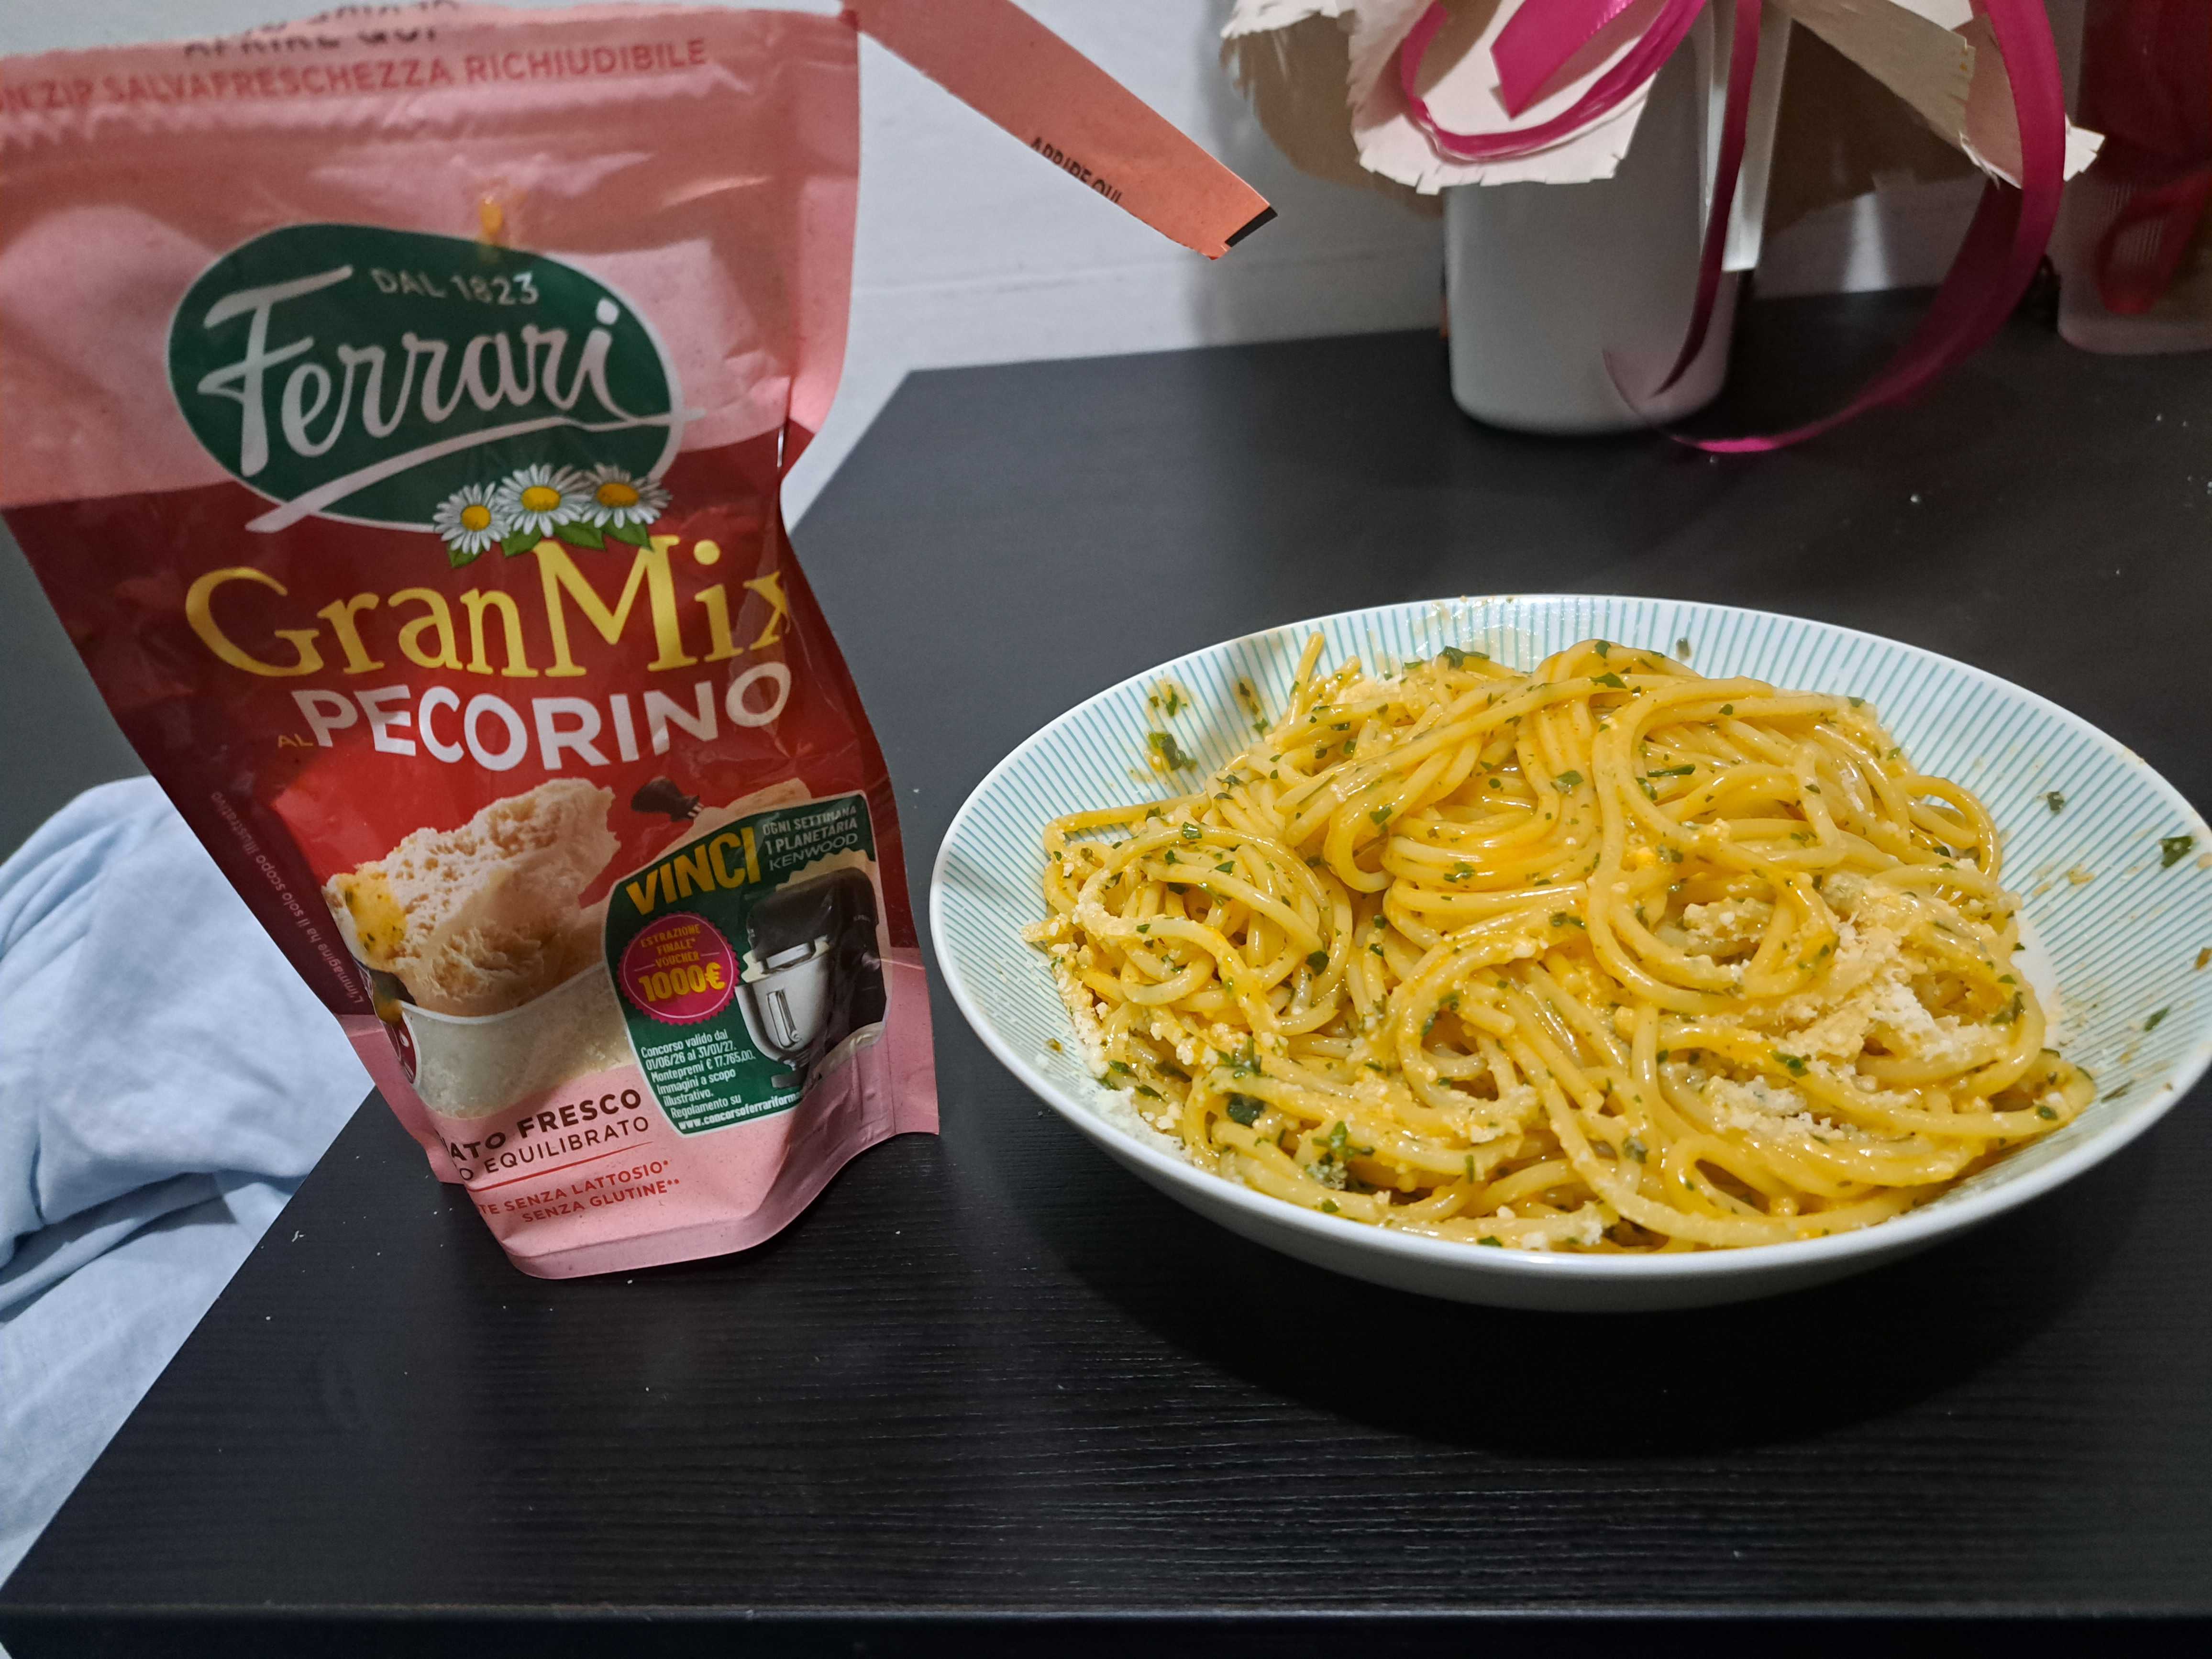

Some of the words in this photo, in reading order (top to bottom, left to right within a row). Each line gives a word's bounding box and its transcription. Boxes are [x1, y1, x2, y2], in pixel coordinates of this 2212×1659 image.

[102, 58, 454, 103] SALVAFRESCHEZZA
[465, 38, 707, 84] RICHIUDIBILE
[370, 266, 447, 298] DAL
[450, 271, 539, 305] 1823
[197, 264, 636, 478] Ferrari
[292, 662, 792, 771] PECORINO
[278, 733, 314, 748] AL
[762, 820, 791, 836] OGNI
[794, 806, 857, 830] SETTIMANA
[765, 841, 773, 855] 1
[775, 818, 858, 853] PLANETARIA
[769, 833, 858, 871] KENWOOD
[256, 855, 286, 891] scopo
[626, 827, 762, 916] VINCI
[282, 893, 304, 917] solo
[296, 918, 310, 928] il
[307, 928, 321, 943] ha
[640, 924, 701, 948] ESTRAZIONE
[318, 943, 365, 1004] L'immagine
[655, 951, 699, 968] VOUCHER
[639, 962, 725, 1002] 1000€
[641, 1041, 684, 1058] Concorso
[685, 1032, 713, 1048] valido
[714, 1029, 728, 1040] dal
[645, 1052, 686, 1071] 01/06/26
[687, 1050, 697, 1061] al
[697, 1040, 737, 1058] 31/01/27.
[651, 1061, 704, 1083] Montepremi
[706, 1059, 713, 1070] €
[656, 1078, 699, 1095] Immagini
[701, 1076, 707, 1085] a
[709, 1069, 736, 1084] scopo
[663, 1089, 714, 1107] illustrativo.
[671, 1098, 729, 1119] Regolamento
[730, 1095, 741, 1105] su
[450, 1131, 506, 1161] ATO
[516, 1089, 641, 1139] FRESCO
[460, 1167, 474, 1181] O
[484, 1116, 649, 1174] EQUILIBRATO
[479, 1204, 500, 1215] TE
[504, 1188, 567, 1212] SENZA
[521, 1201, 585, 1223] SENZA
